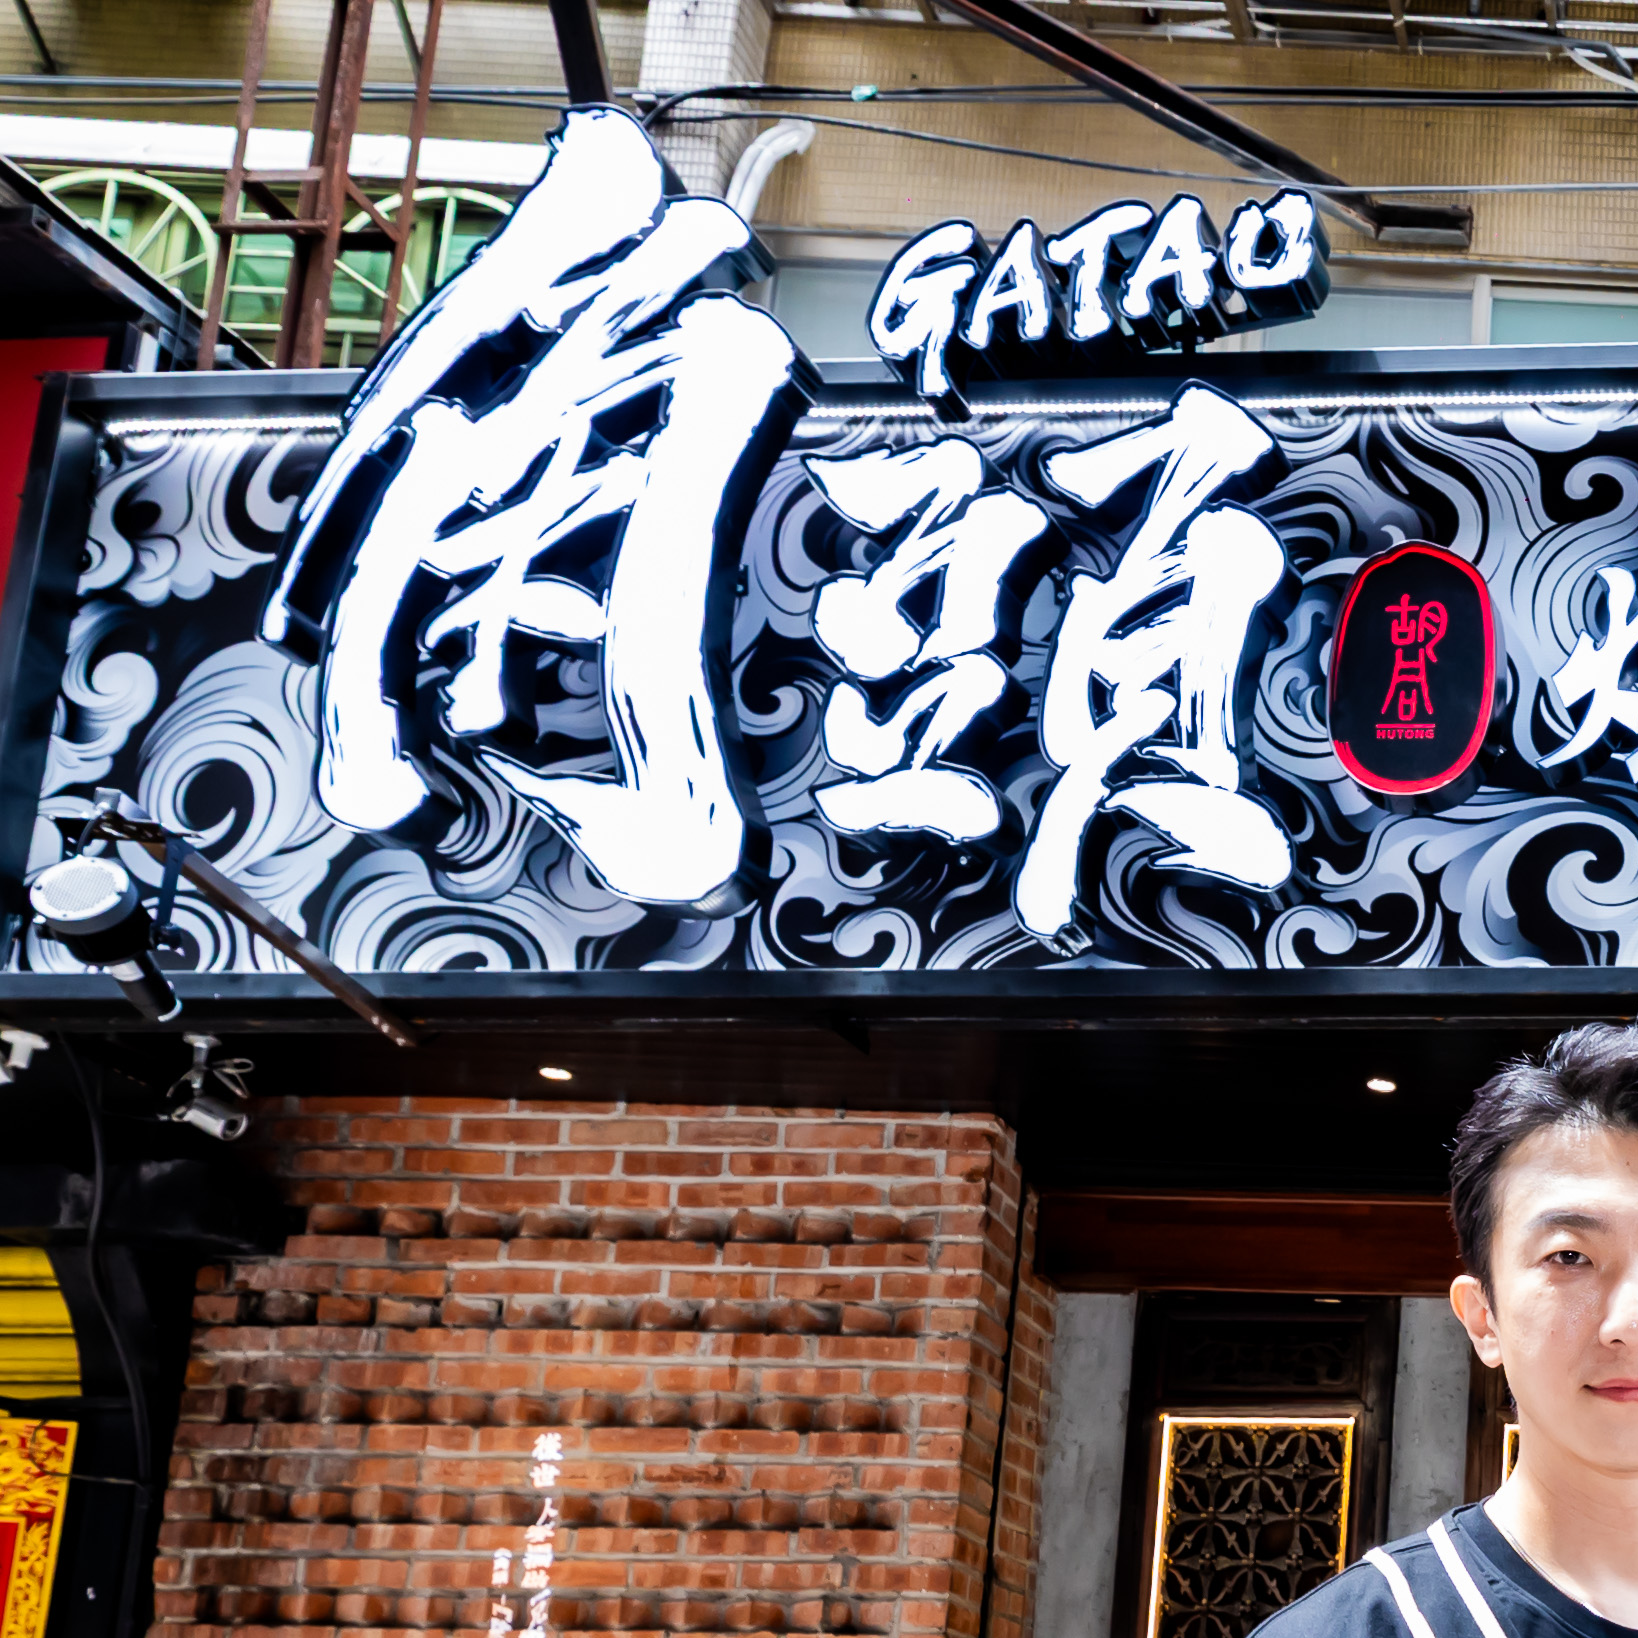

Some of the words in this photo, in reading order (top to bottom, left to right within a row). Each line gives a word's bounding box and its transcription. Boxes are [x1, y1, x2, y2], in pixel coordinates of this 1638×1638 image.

[868, 188, 1316, 398] GATAO
[259, 103, 1297, 940] 角頭
[1376, 728, 1435, 740] HUTONG
